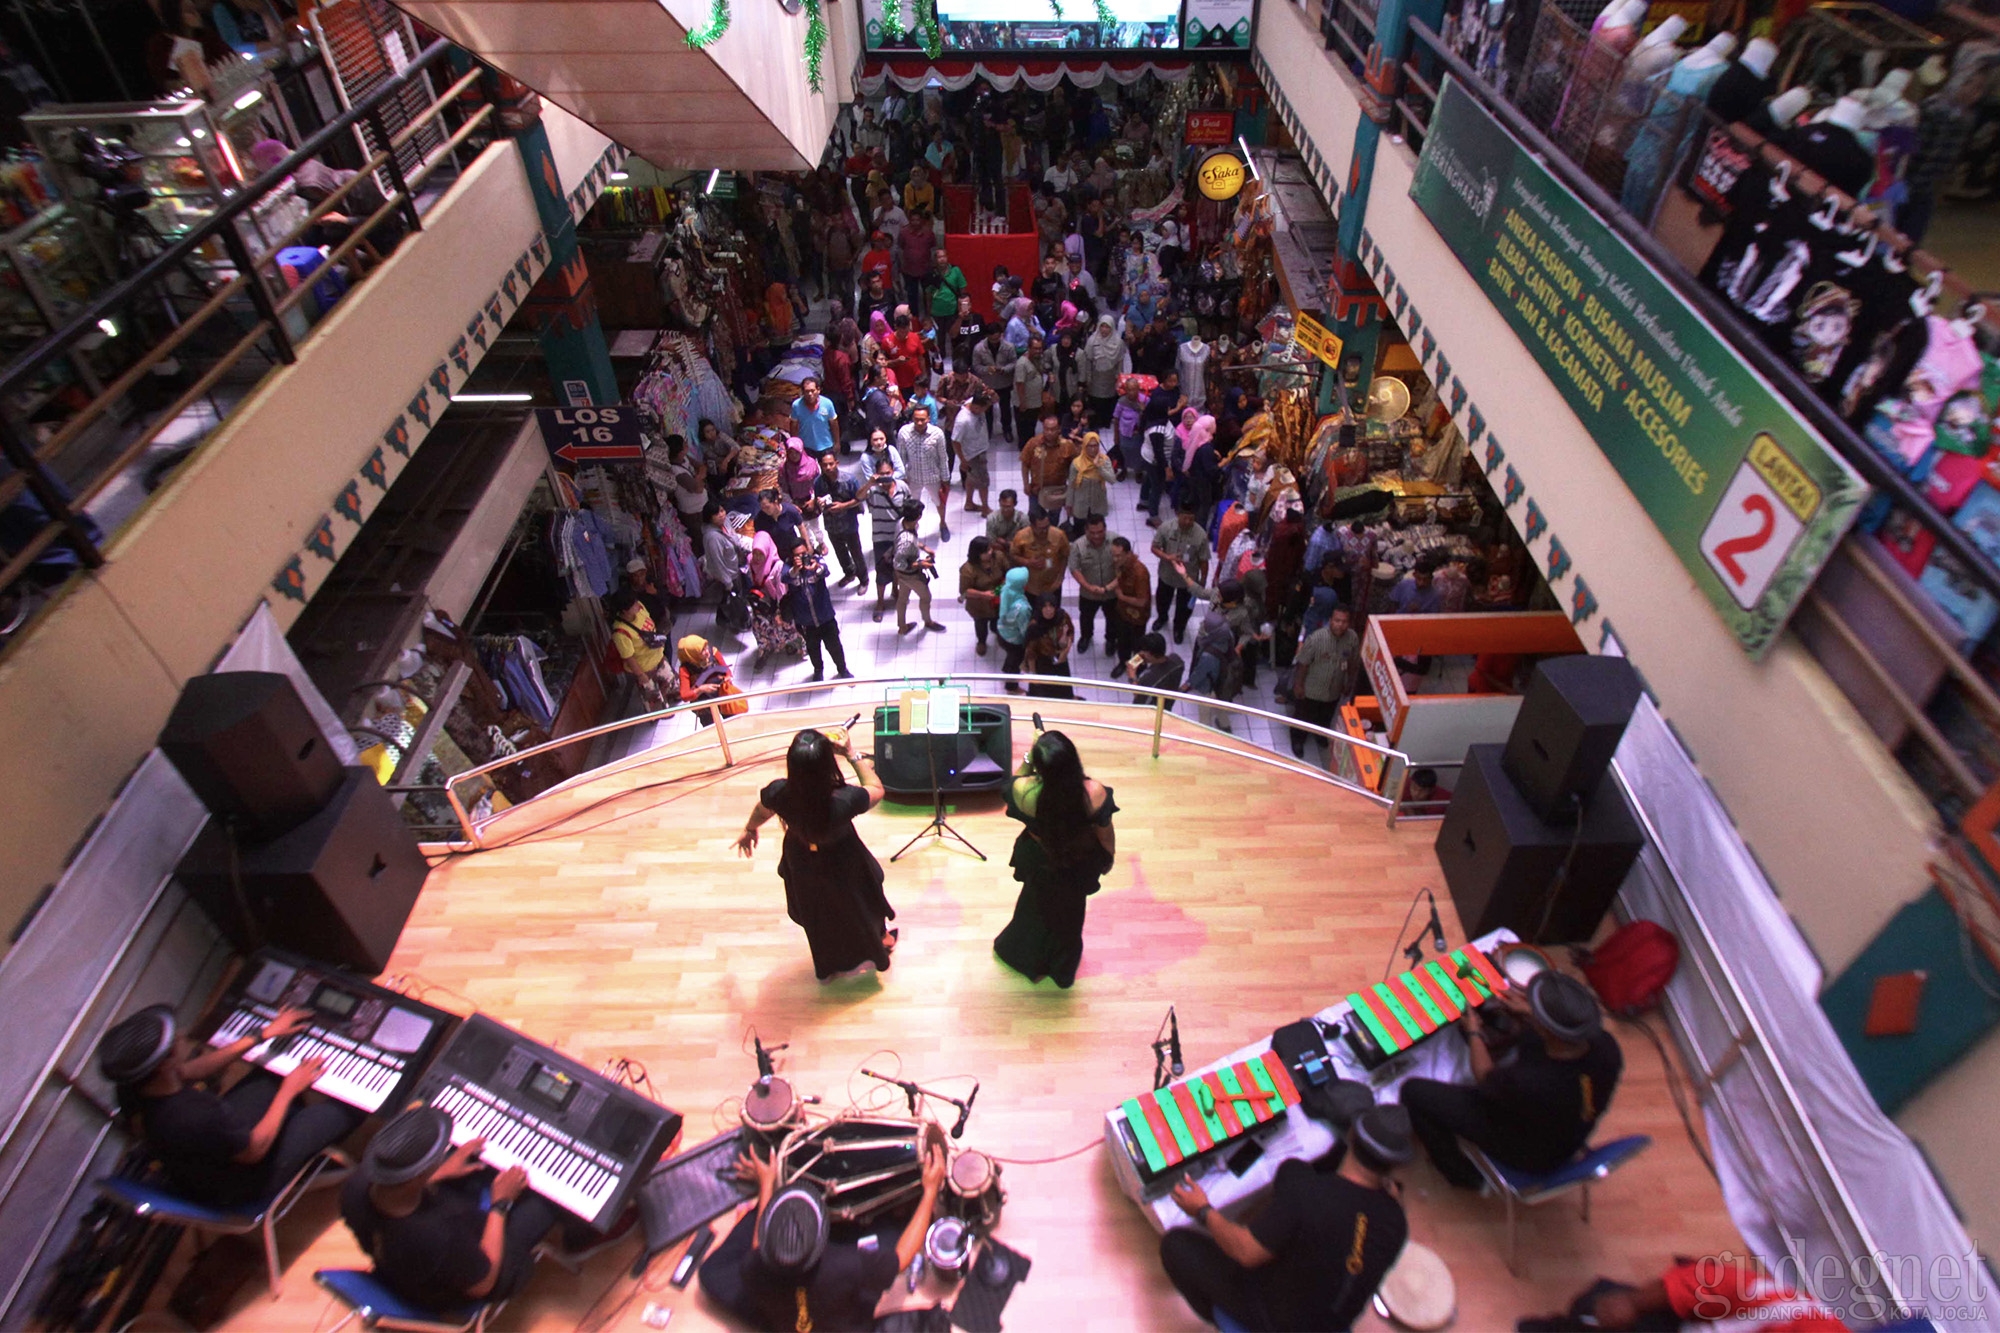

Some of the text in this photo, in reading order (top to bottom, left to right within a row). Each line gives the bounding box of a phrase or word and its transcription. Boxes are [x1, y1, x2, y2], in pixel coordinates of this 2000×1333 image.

[1202, 165, 1240, 184] Saka
[1429, 146, 1484, 217] BERINGHARJO
[1489, 257, 1604, 412] BATIK JAM & KACAMATA
[1504, 208, 1693, 428] ANEKA FASHION BUSANA MUSLIM
[1496, 233, 1709, 495] JILBAB CANTIK KOSMETIK ACCESORIES
[554, 408, 620, 424] LOS
[572, 426, 614, 442] 16
[1754, 443, 1813, 511] LANTAI
[1713, 492, 1776, 586] 2
